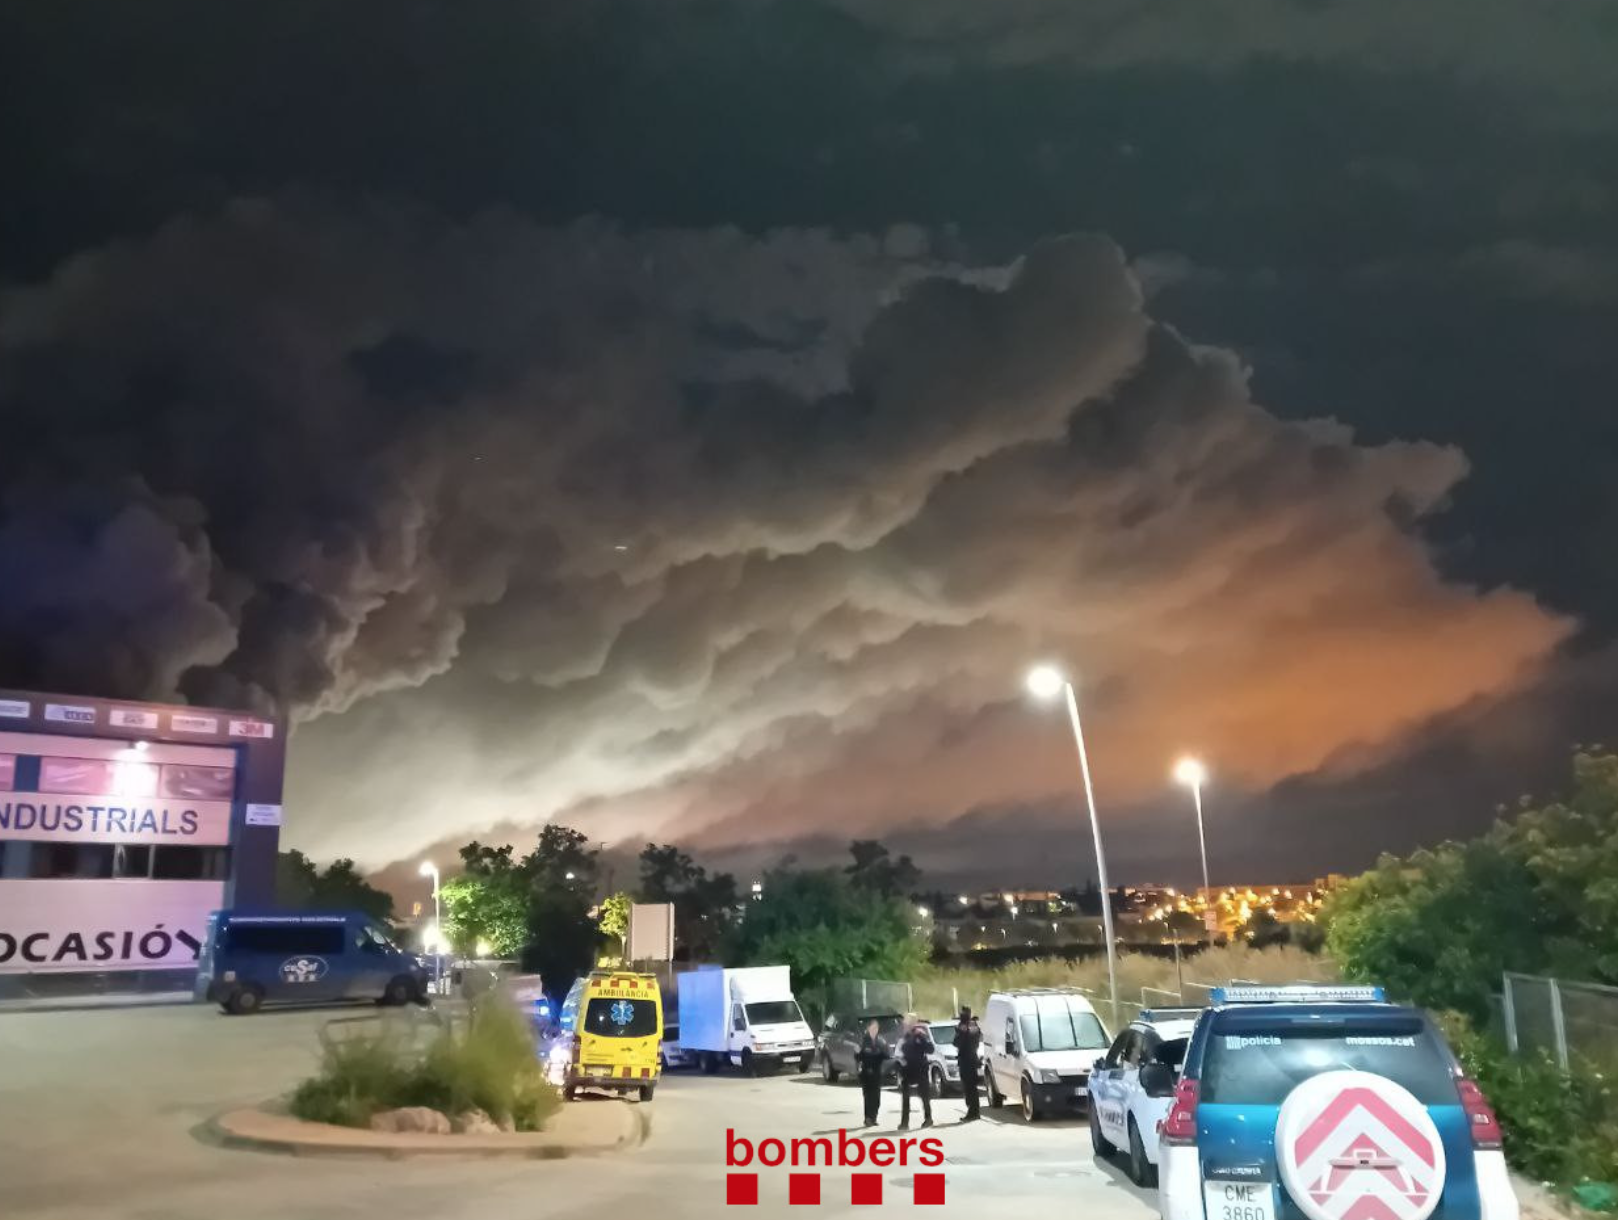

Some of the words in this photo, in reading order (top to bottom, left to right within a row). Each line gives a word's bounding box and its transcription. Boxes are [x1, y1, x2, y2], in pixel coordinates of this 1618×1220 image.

[1346, 1037, 1415, 1047] mossos.cat
[1225, 1185, 1256, 1202] CME
[1223, 1206, 1264, 1220] 3860
